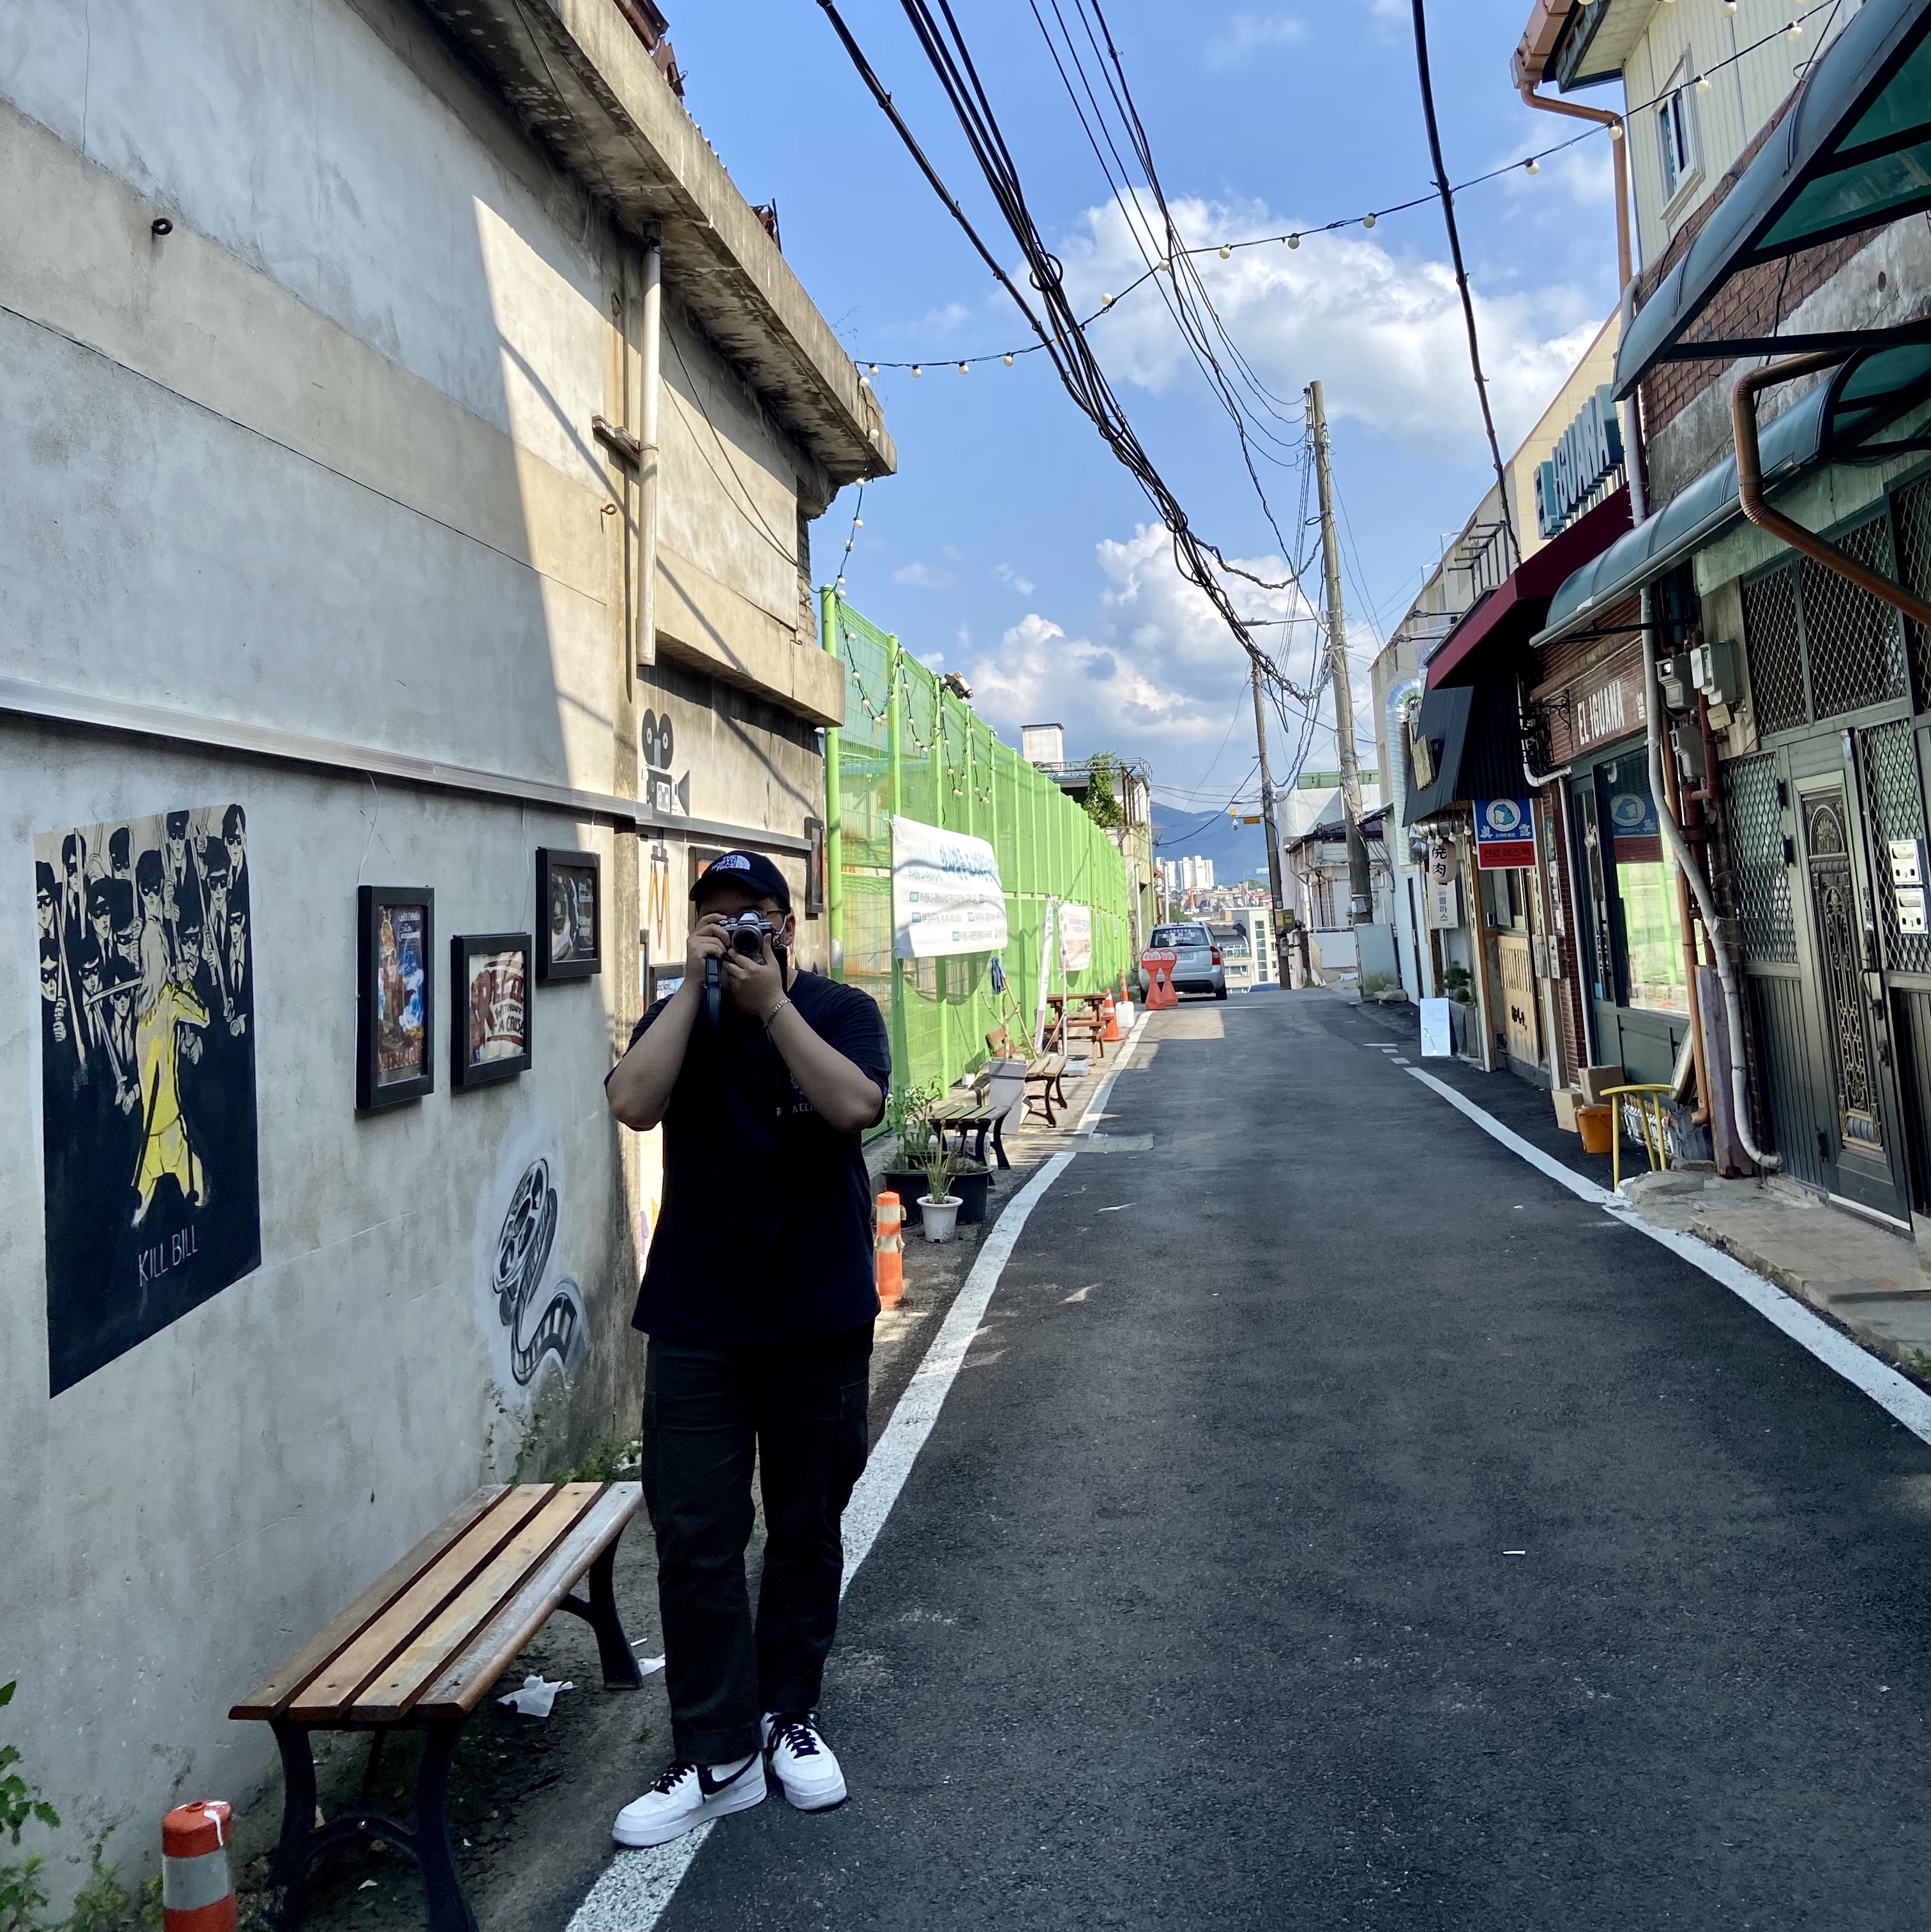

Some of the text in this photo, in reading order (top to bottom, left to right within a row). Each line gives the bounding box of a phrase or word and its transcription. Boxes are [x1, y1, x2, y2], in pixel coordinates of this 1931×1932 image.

[1550, 384, 1617, 521] IGUANA
[1577, 681, 1625, 746] EL IGUANA
[1483, 847, 1531, 858] 진로 이즈 백
[139, 1225, 198, 1287] KILL BILL
